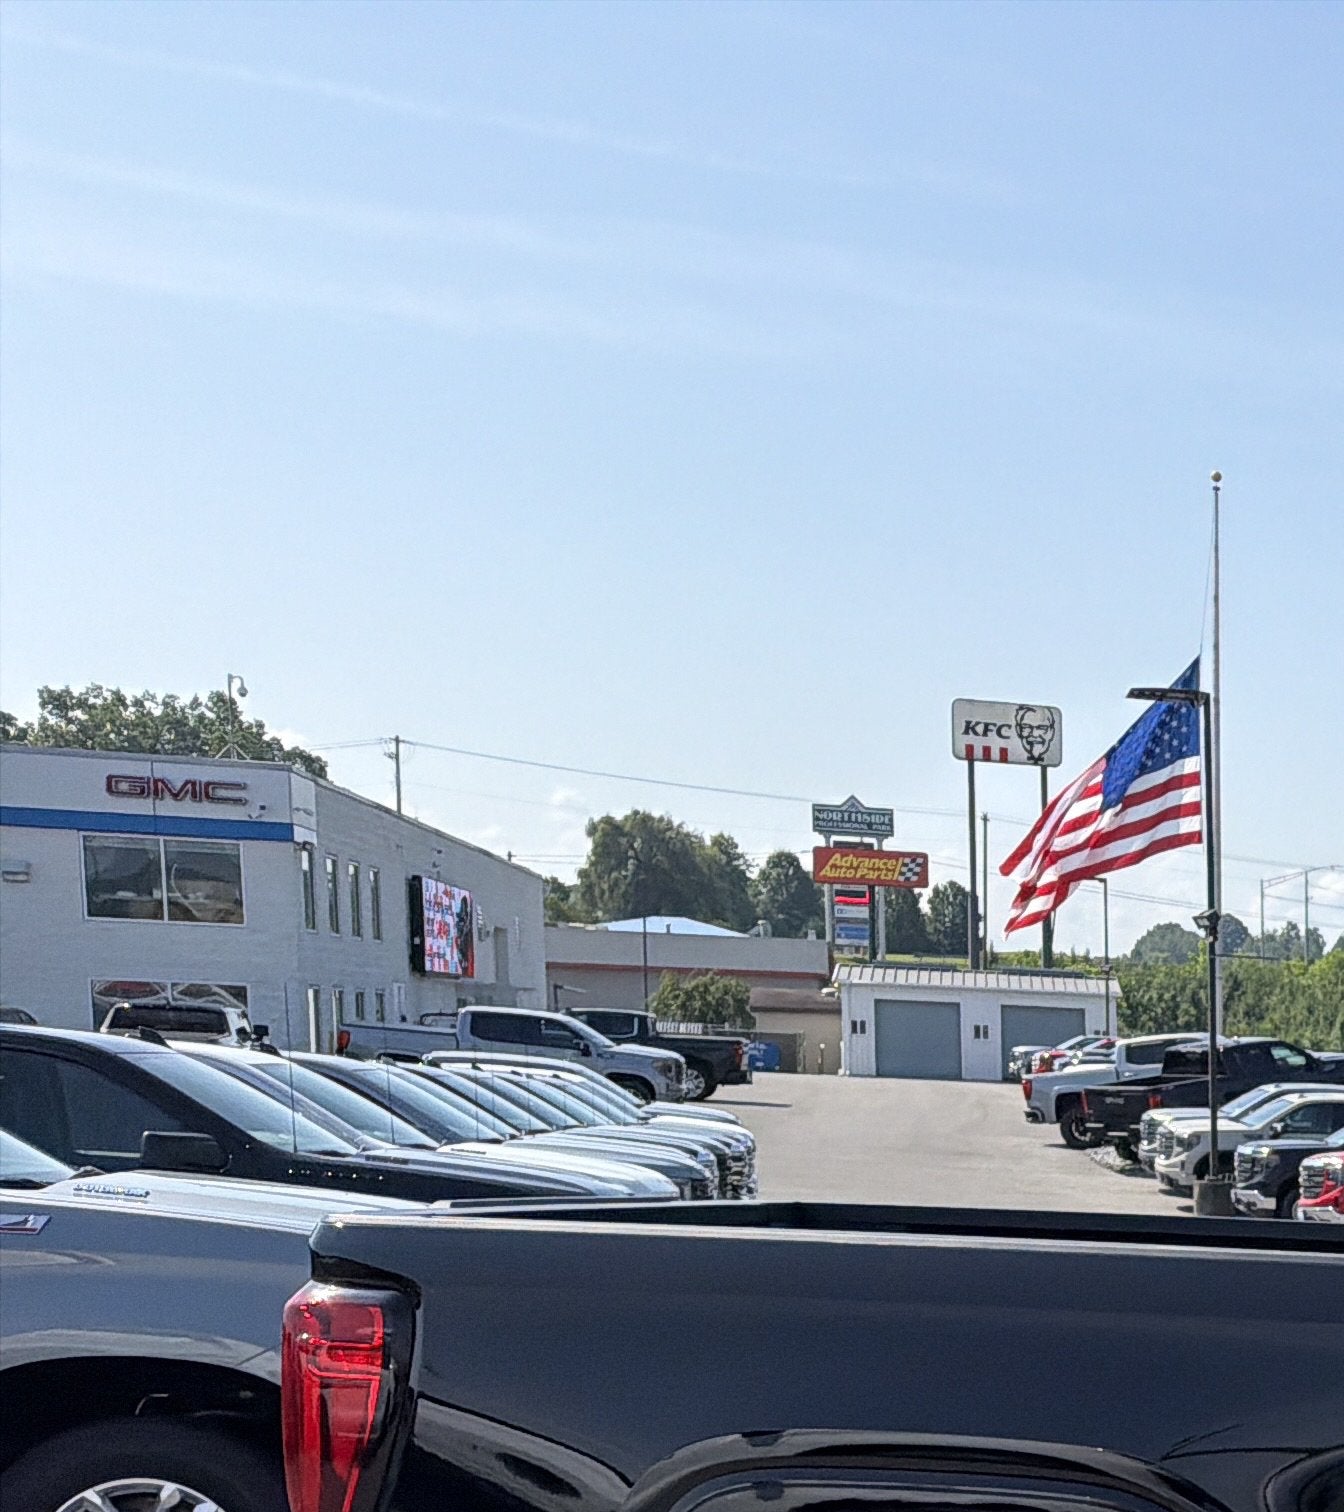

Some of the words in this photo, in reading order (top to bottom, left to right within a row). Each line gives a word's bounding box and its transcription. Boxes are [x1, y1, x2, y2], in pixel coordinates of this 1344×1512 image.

[962, 720, 1012, 739] KFC
[106, 774, 248, 806] GMC
[814, 810, 892, 825] NORTHSIDE
[827, 853, 896, 869] Advance
[820, 866, 855, 878] Auto
[855, 867, 893, 880] Parts
